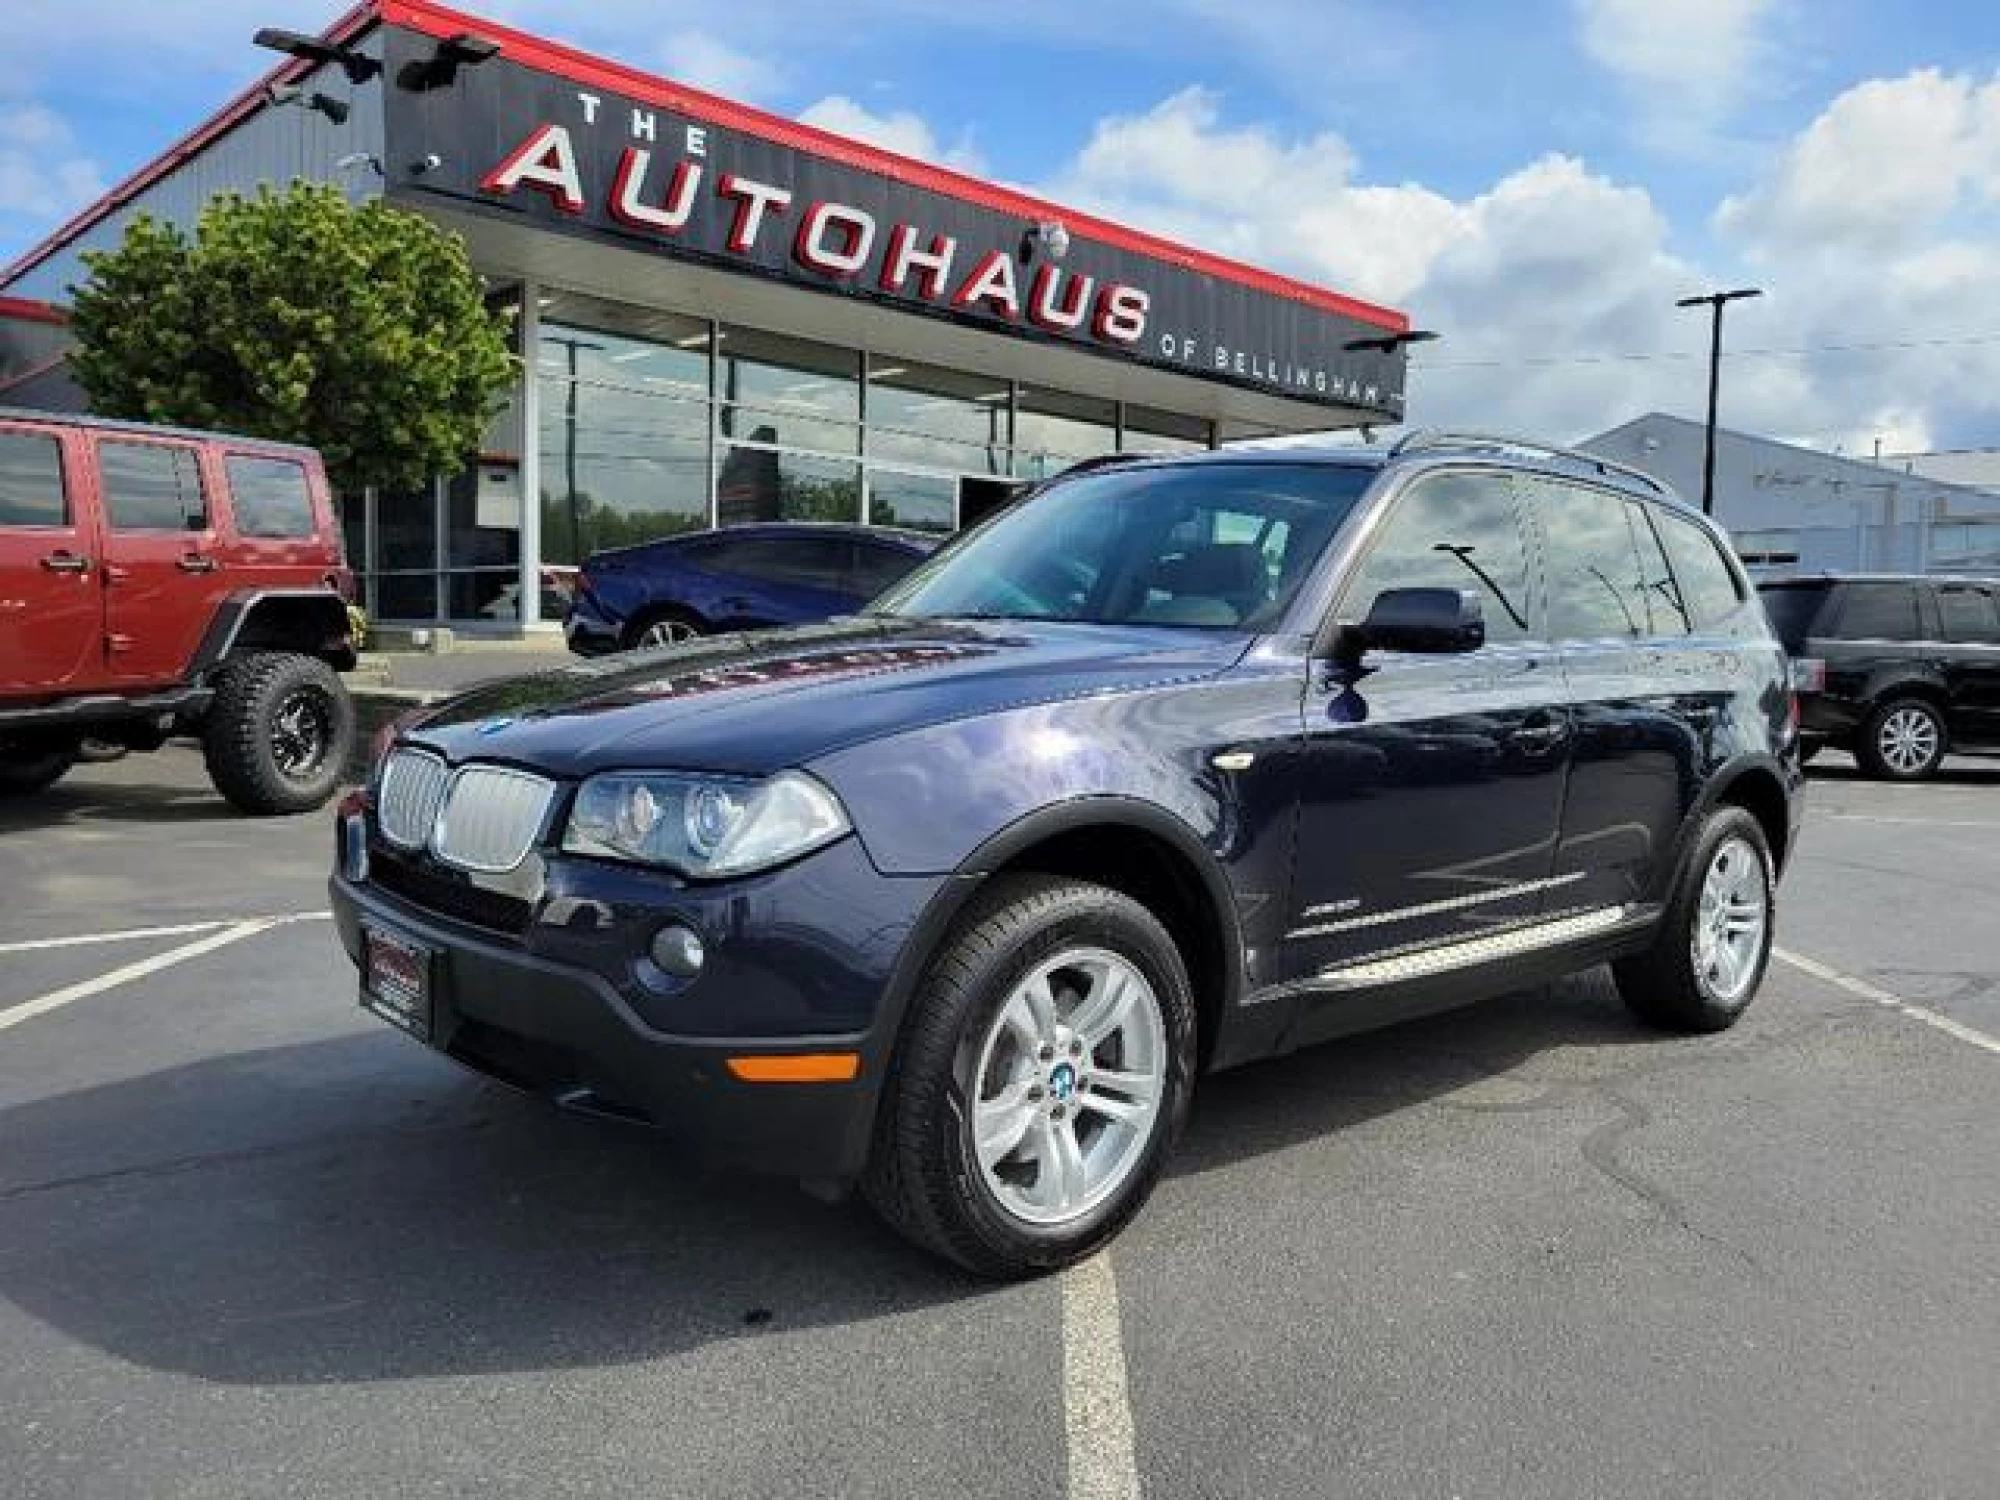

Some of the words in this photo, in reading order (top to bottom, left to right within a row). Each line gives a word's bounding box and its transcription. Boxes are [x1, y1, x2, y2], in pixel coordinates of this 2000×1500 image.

[578, 93, 707, 156] THE
[479, 122, 1151, 343] AUTOHAUS
[1159, 333, 1195, 360] OF
[1215, 346, 1378, 404] BELLINGHAM
